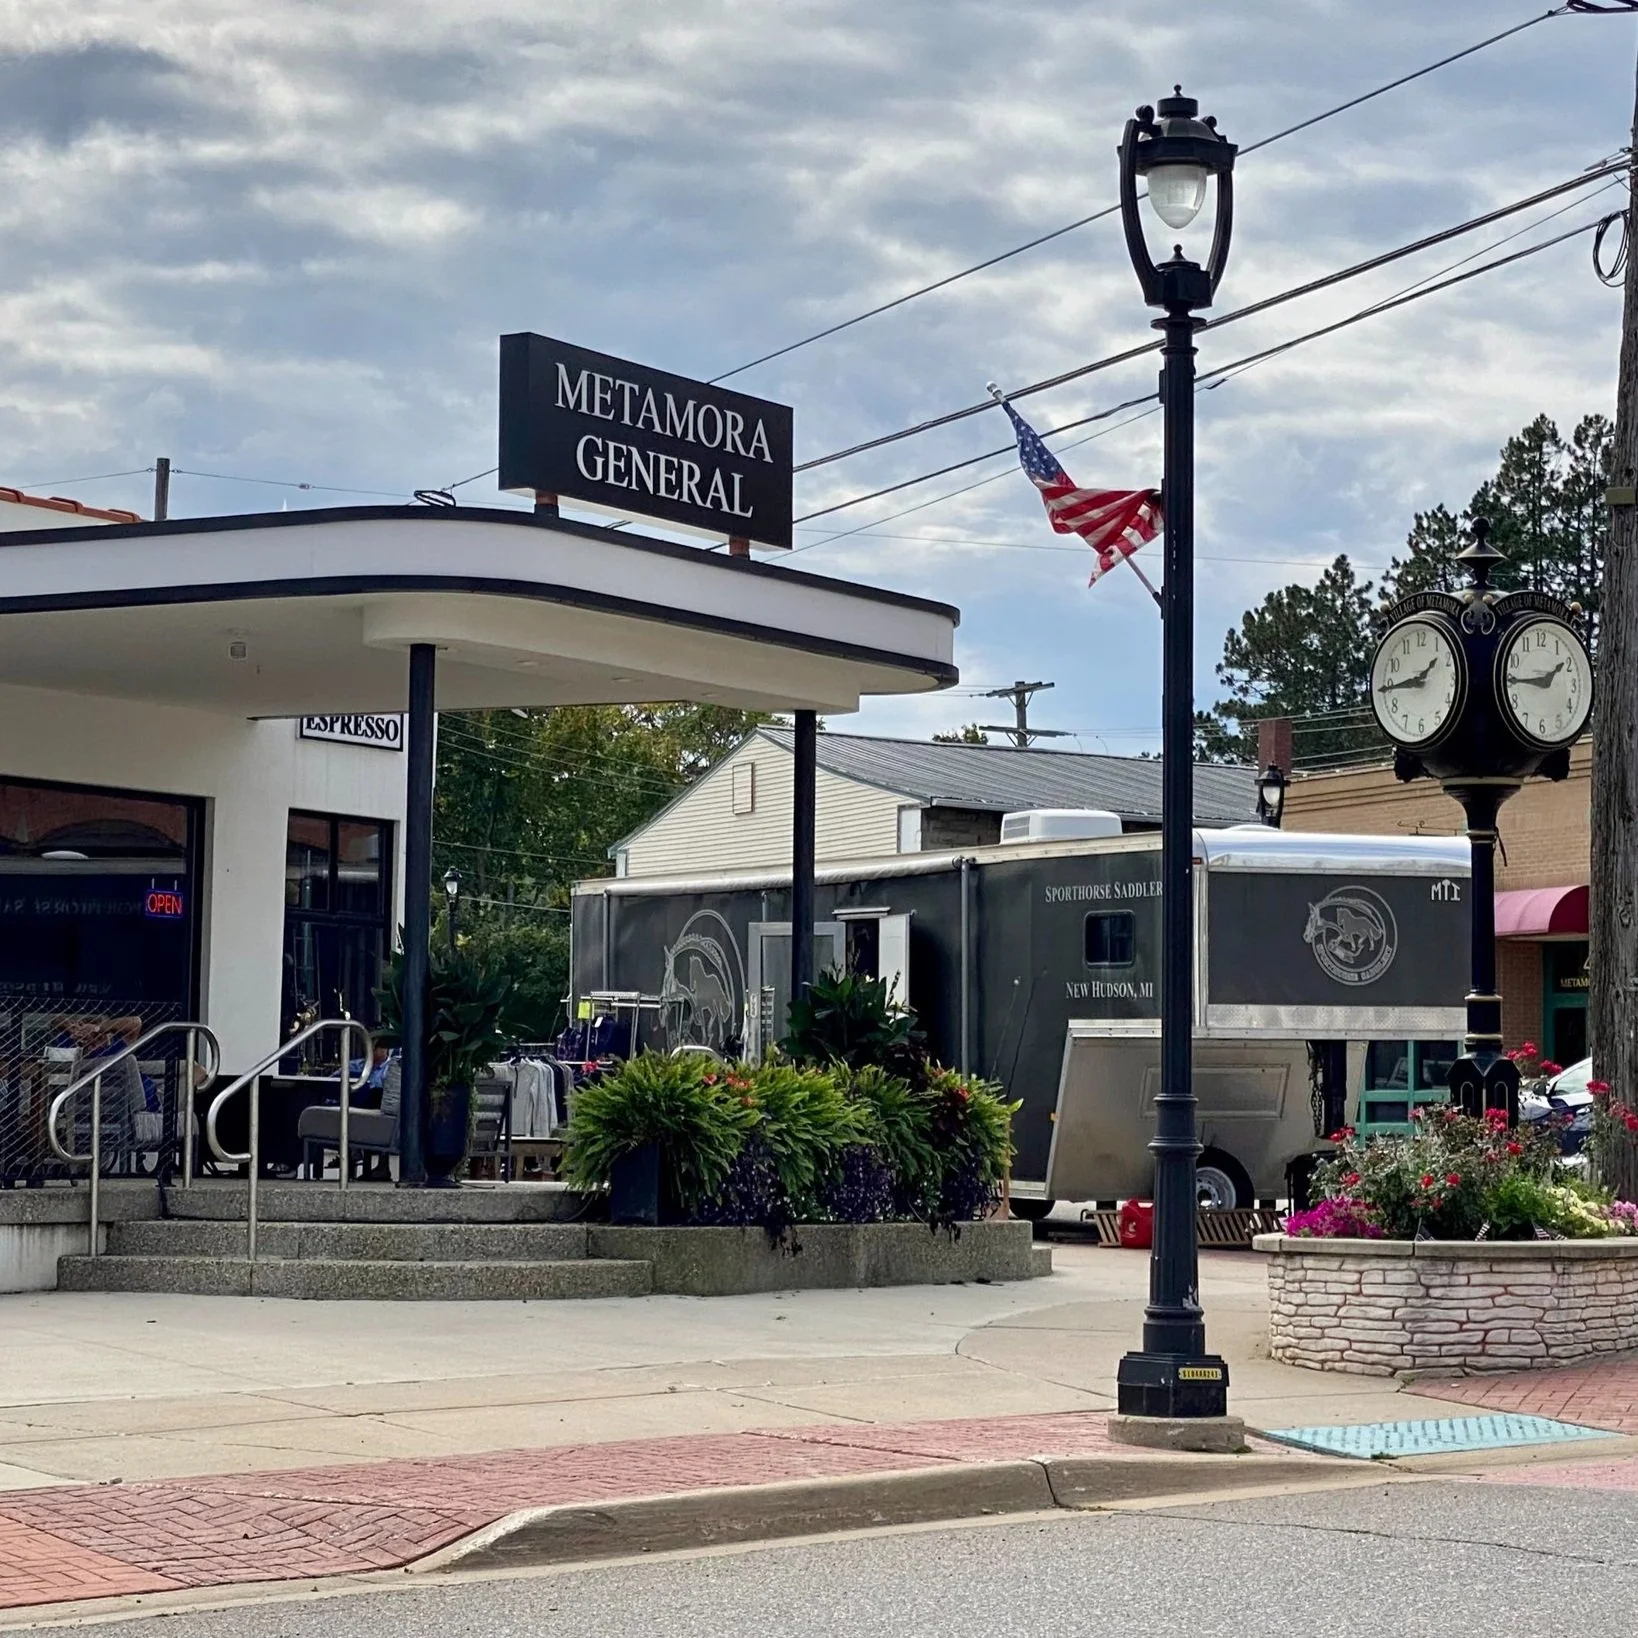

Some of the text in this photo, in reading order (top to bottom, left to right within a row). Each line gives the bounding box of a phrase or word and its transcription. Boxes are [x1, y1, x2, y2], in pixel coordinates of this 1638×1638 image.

[554, 362, 774, 463] METAMORA
[576, 434, 754, 519] GENERAL
[1389, 595, 1461, 622] VILLAGE OF METAMORA
[1496, 594, 1569, 623] VILLAGE OF METAMORA
[1402, 639, 1410, 655] 11
[1416, 631, 1426, 647] 12
[1434, 636, 1439, 652] 1
[1522, 637, 1530, 652] 11
[1536, 632, 1546, 647] 12
[1554, 640, 1559, 655] 1
[1389, 658, 1400, 673] 10
[1445, 651, 1451, 667] 2
[1510, 653, 1520, 668] 10
[1566, 657, 1572, 672] 2
[1571, 678, 1577, 693] 3
[1391, 697, 1398, 713] 8
[1445, 692, 1451, 708] 4
[1511, 694, 1518, 710] 8
[1566, 697, 1573, 714] 4
[1402, 714, 1409, 729] 7
[1418, 718, 1424, 733] 6
[1434, 710, 1441, 726] 5
[1522, 712, 1529, 727] 7
[1539, 718, 1546, 734] 6
[305, 715, 399, 742] ESPRESSO
[1045, 881, 1163, 903] SPORTHORSE SADDLER
[147, 893, 183, 914] OPEN
[1066, 980, 1153, 1000] NEW HUDSON, MI
